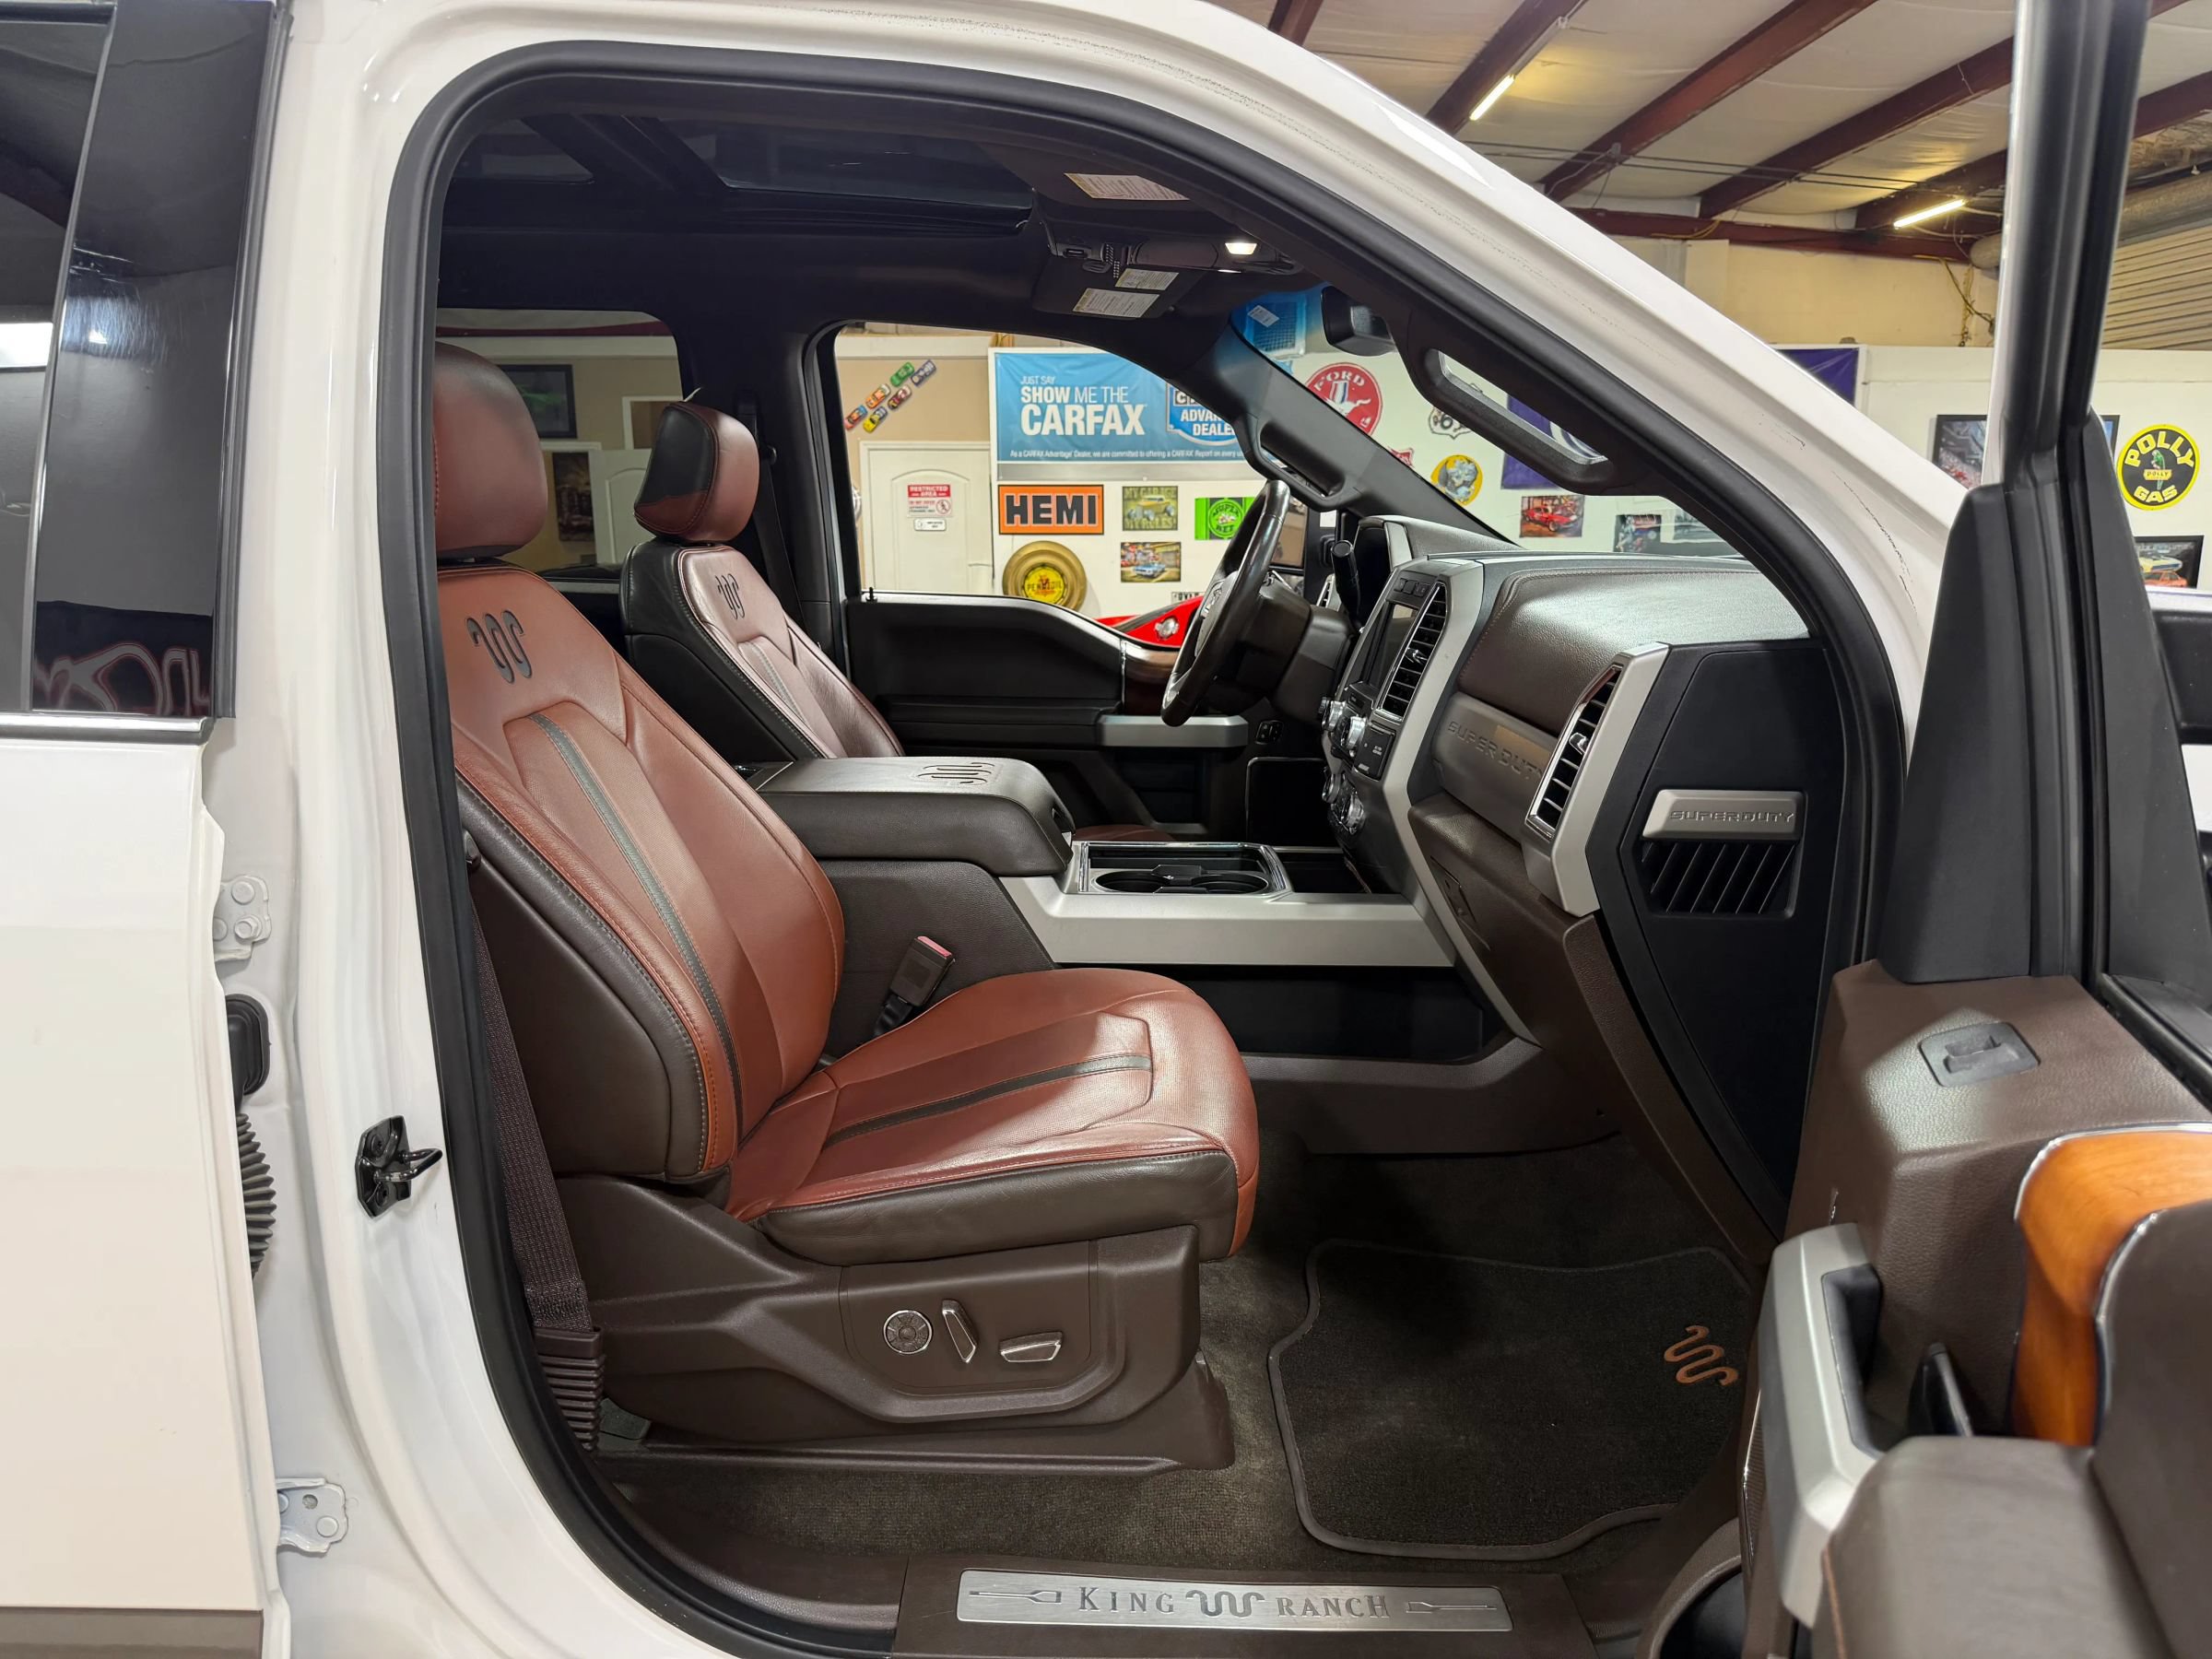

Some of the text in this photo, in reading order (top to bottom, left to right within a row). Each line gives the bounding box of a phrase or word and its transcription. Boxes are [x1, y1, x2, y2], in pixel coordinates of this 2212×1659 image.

[1020, 376, 1056, 385] JUST SAY
[1313, 371, 1365, 392] FORD
[1020, 386, 1129, 403] SHOW ME THE
[1020, 404, 1146, 435] CARFAX
[1193, 423, 1236, 436] DEALE
[2124, 430, 2194, 467] POLLY
[2134, 485, 2178, 503] GAS
[1006, 494, 1097, 525] HEMI
[1447, 721, 1498, 759] SUPER
[1078, 1586, 1392, 1619] KING RANCH
